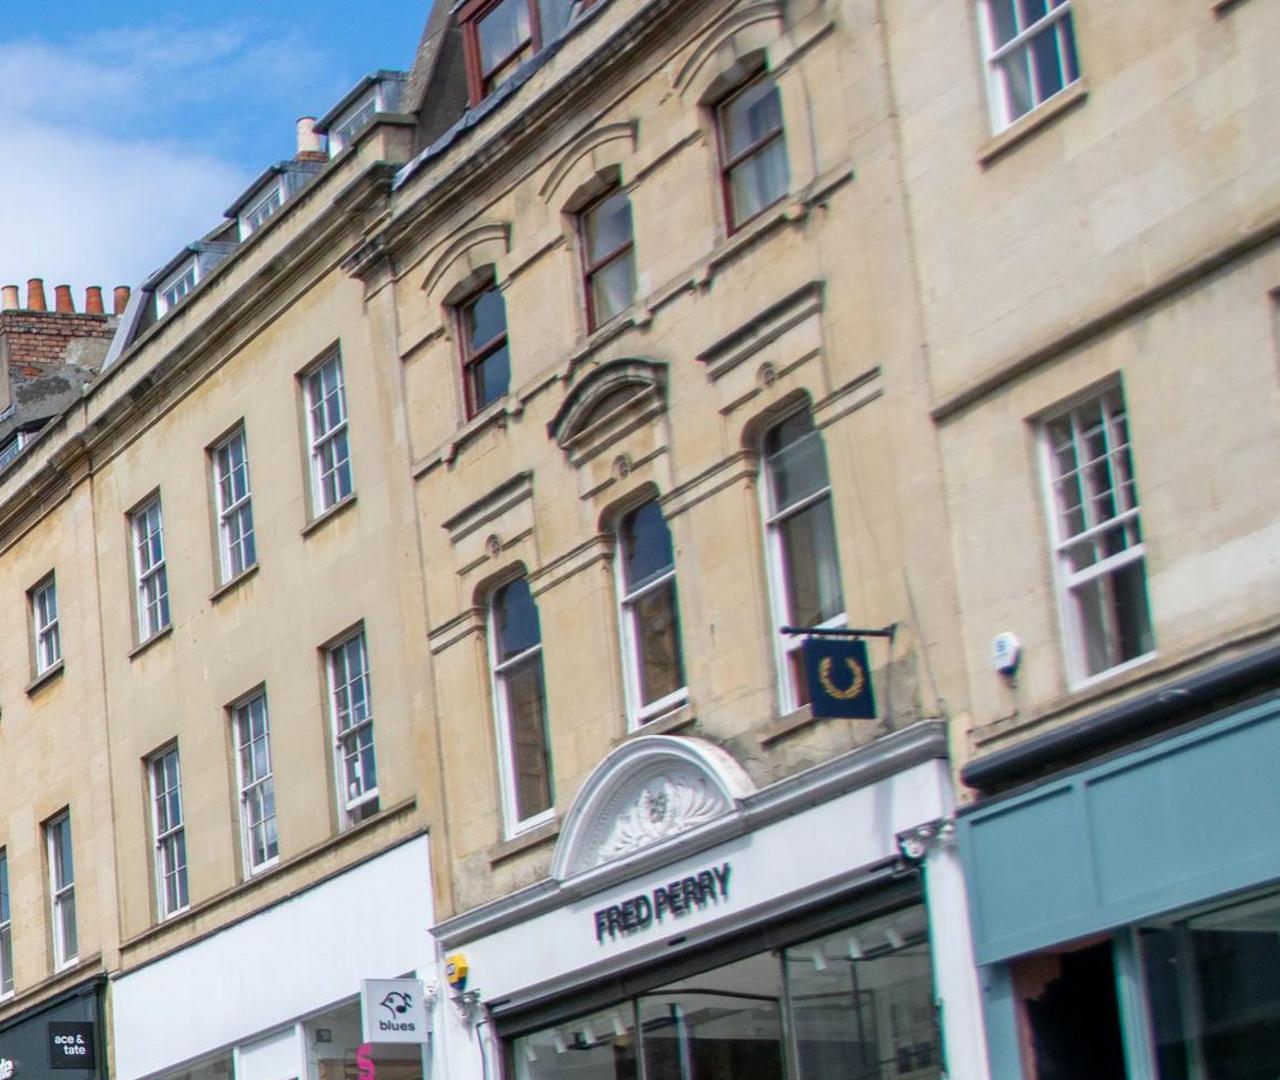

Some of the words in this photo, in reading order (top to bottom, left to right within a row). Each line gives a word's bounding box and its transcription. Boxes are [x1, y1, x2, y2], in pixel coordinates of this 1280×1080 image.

[594, 894, 653, 942] FRED
[653, 862, 731, 921] PERRY
[379, 1020, 416, 1031] blues
[54, 1035, 74, 1044] ace
[76, 1034, 85, 1044] &
[63, 1045, 86, 1055] tate
